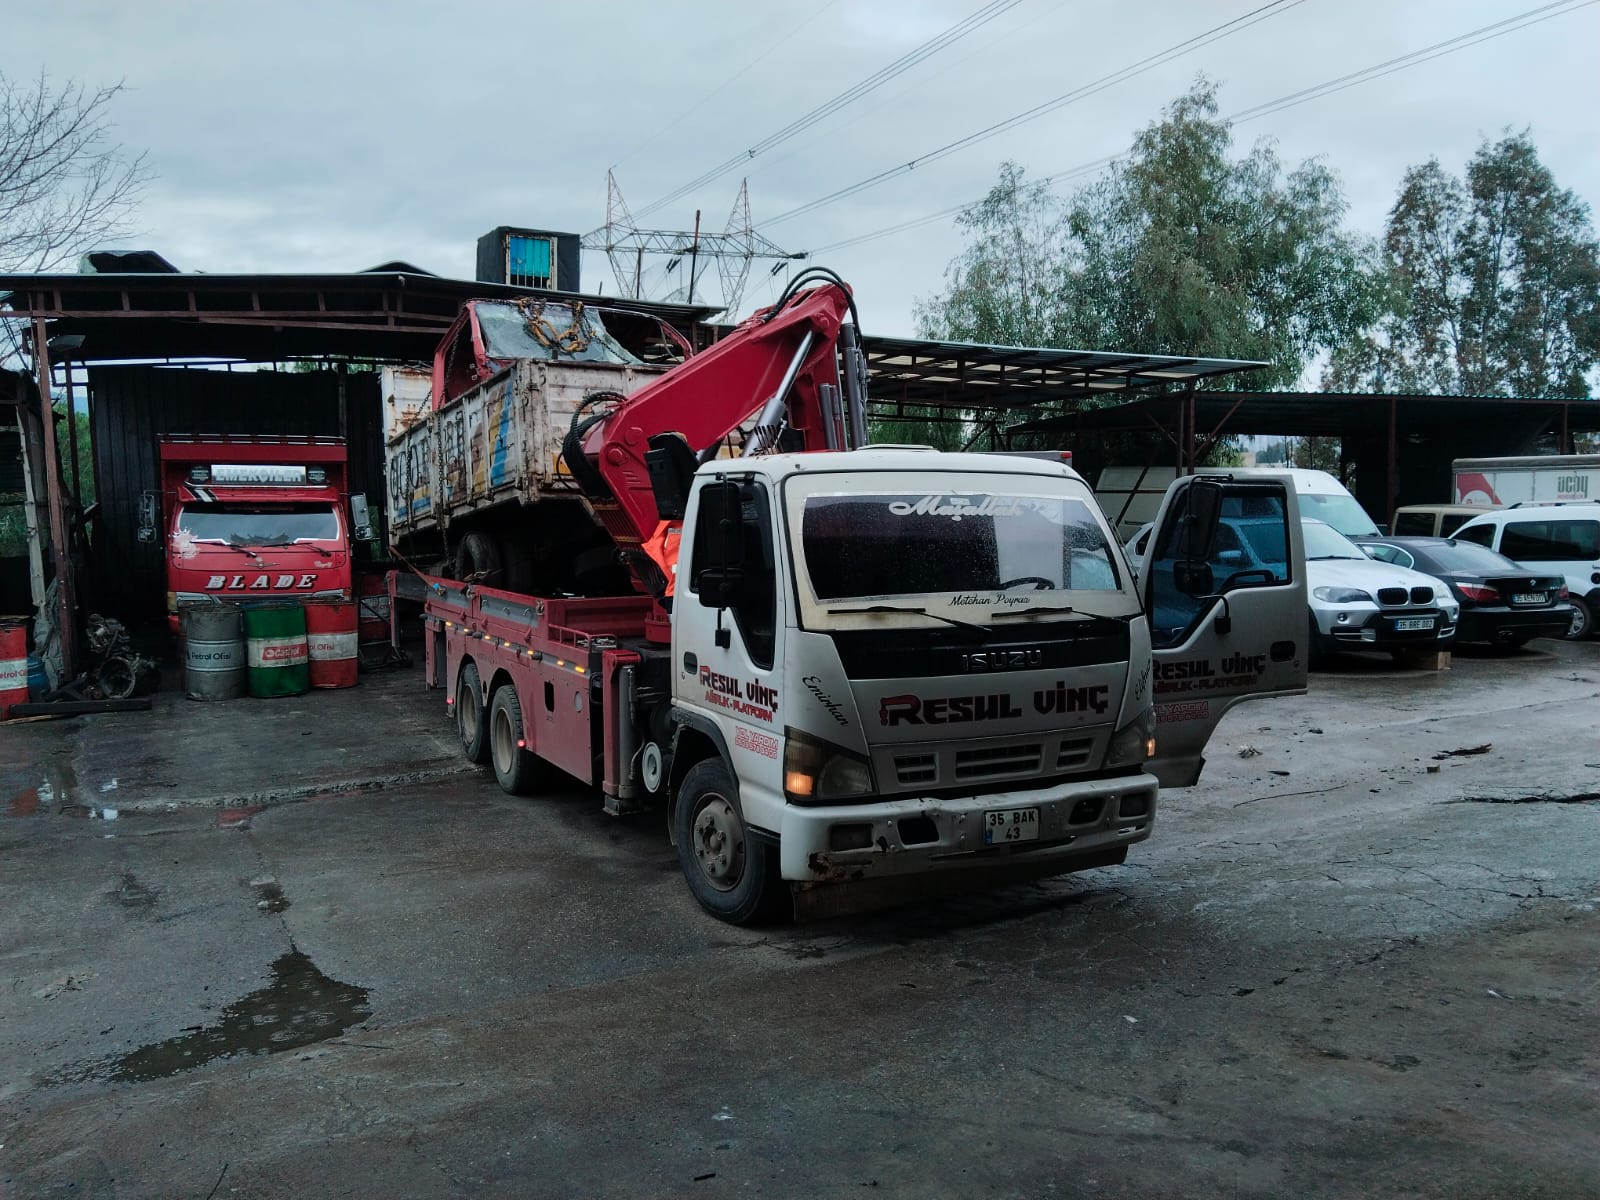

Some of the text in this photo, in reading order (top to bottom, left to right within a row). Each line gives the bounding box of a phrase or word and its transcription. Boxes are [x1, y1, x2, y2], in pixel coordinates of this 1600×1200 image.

[205, 574, 317, 590] BLADE
[948, 592, 1031, 607] Metehan Poyraz
[191, 652, 231, 660] Petrol Ofisi
[274, 647, 300, 657] Castrol
[961, 649, 1041, 671] ISUZU
[0, 670, 18, 679] etrol
[1152, 659, 1215, 681] RESUL
[700, 665, 742, 698] RESUL
[802, 676, 849, 727] Emirhan
[880, 681, 1109, 726] RESUL VİNÇ
[990, 811, 1035, 826] 35 BAK
[1006, 827, 1021, 840] 43
